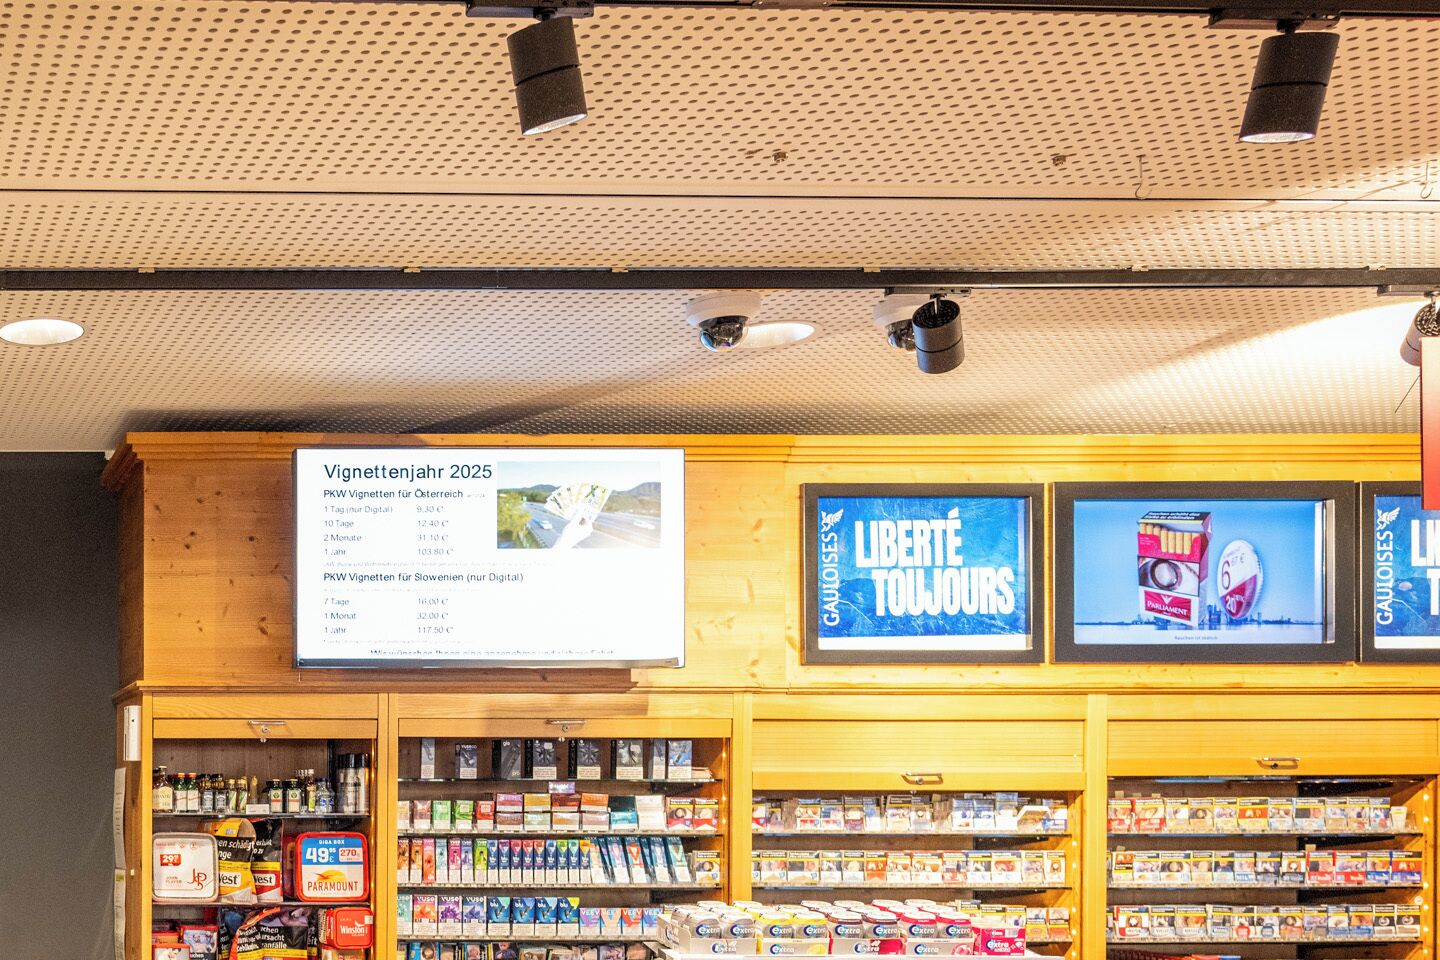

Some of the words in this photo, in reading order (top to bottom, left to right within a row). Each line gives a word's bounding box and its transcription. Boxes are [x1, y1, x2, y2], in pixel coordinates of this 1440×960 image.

[324, 464, 444, 482] Vignettenjahr
[450, 464, 492, 479] 2025
[324, 490, 346, 498] PKW
[349, 490, 394, 501] Vignetten
[398, 489, 411, 498] für
[414, 488, 463, 498] Österreich
[330, 506, 344, 515] Tag
[336, 520, 354, 529] Tage
[855, 507, 963, 568] LIBERTÉ
[324, 573, 346, 582] PKW
[349, 573, 395, 584] Vignetten
[398, 572, 411, 582] für
[414, 572, 464, 582] Slowenien
[467, 572, 486, 583] (nur
[489, 572, 524, 583] Digital)
[822, 532, 840, 626] GAULOISES
[1376, 530, 1394, 625] GAULOISES
[872, 567, 1015, 616] TOUJOURS
[331, 598, 349, 608] Tage
[1147, 601, 1187, 615] PARLIAMENT
[308, 881, 358, 891] PARAMOUNT
[340, 925, 365, 934] Winston
